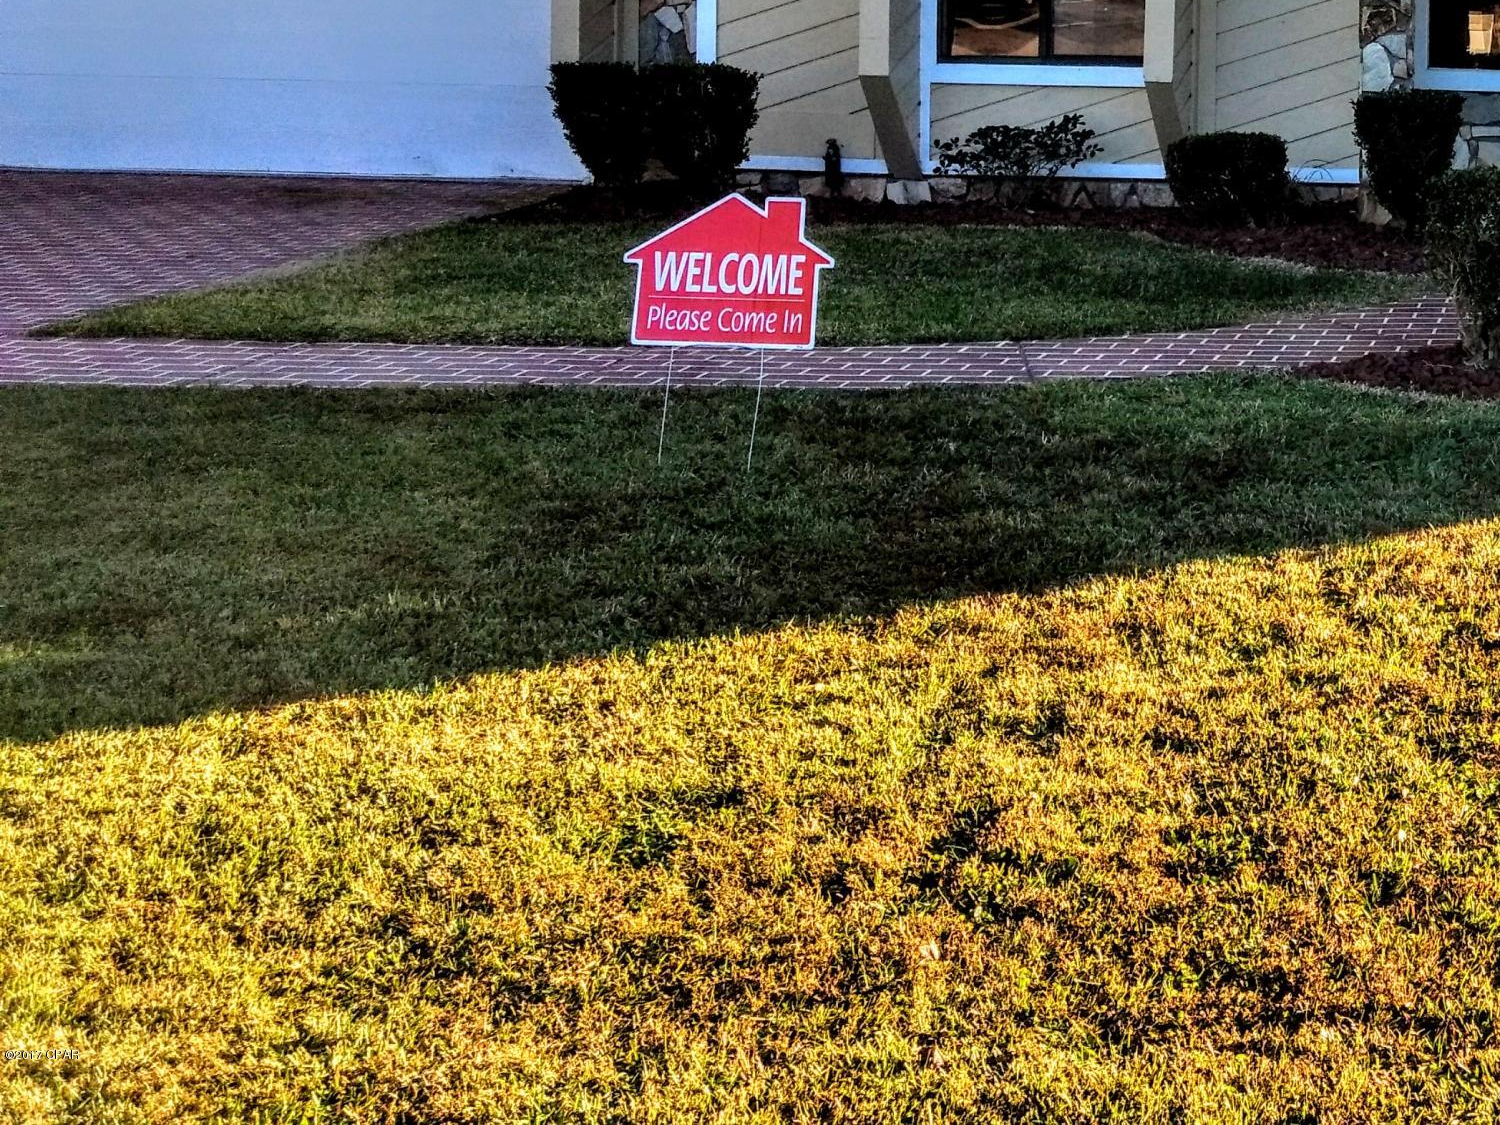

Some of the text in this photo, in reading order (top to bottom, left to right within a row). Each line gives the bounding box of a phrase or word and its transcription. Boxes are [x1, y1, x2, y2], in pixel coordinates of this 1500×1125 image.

[654, 250, 806, 296] WELCOME
[647, 302, 803, 334] Please Come In
